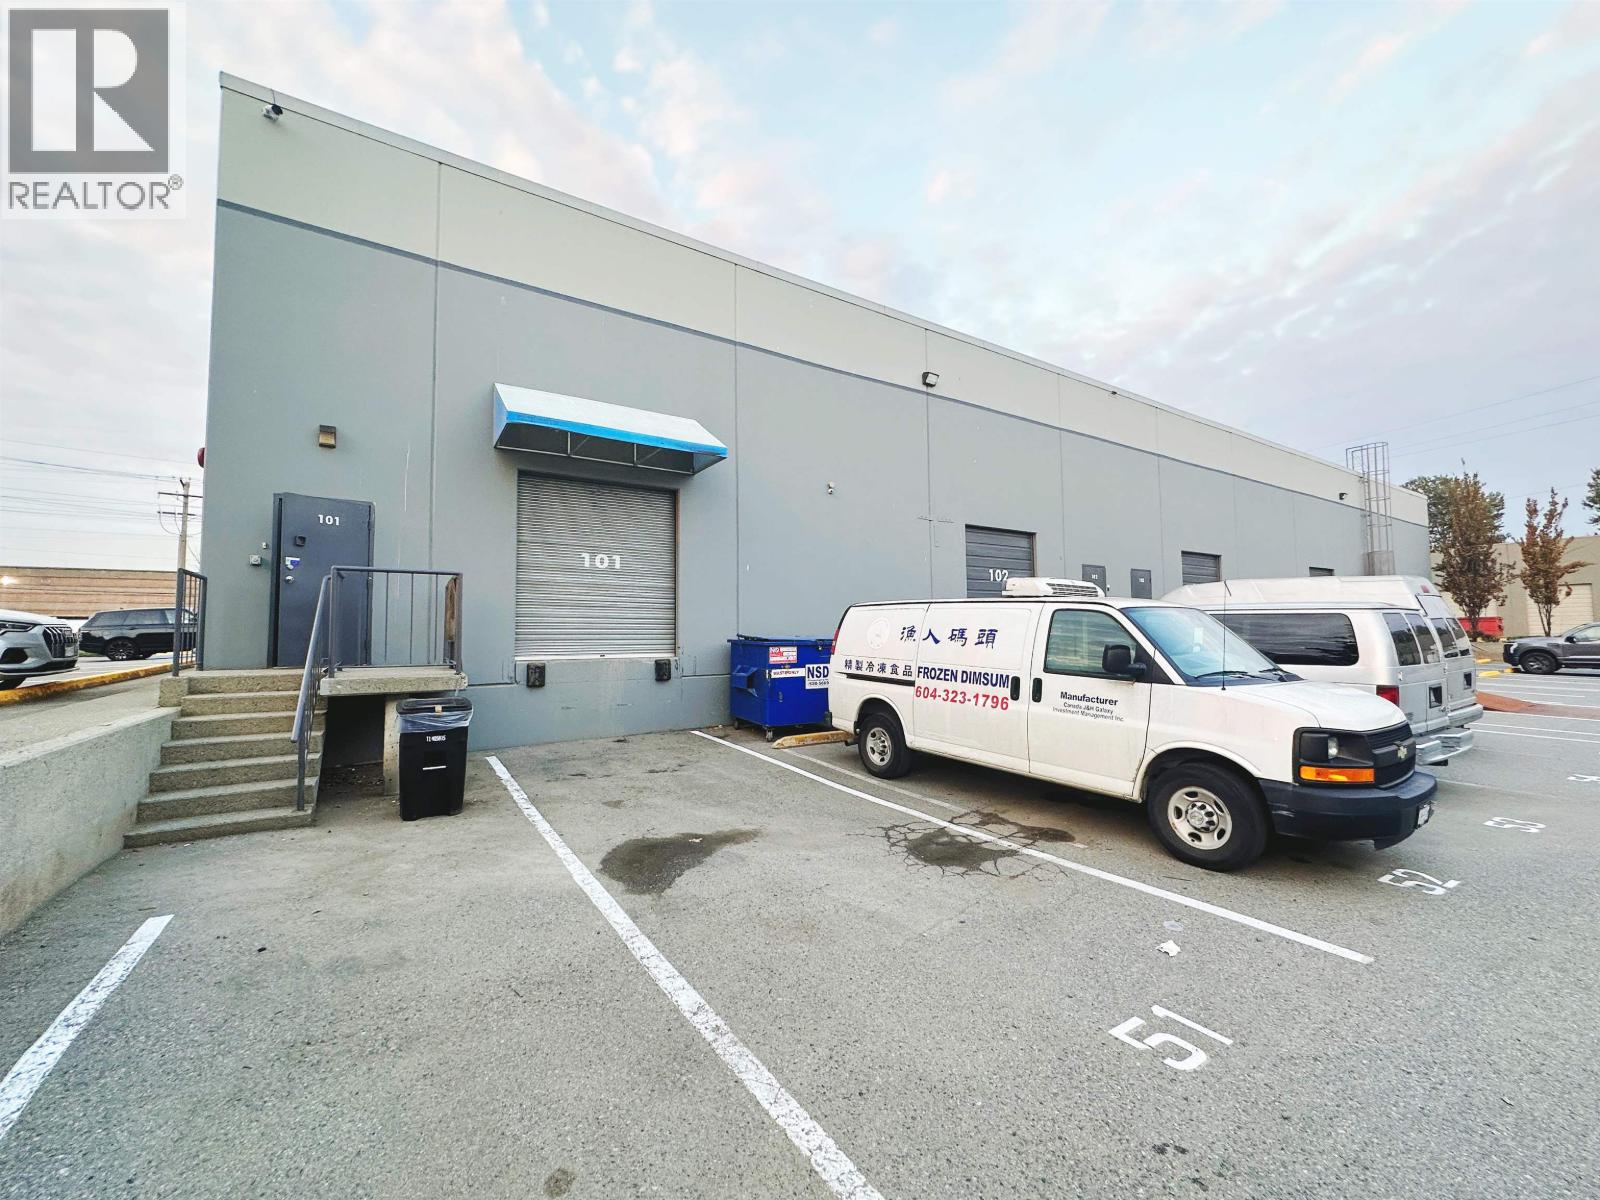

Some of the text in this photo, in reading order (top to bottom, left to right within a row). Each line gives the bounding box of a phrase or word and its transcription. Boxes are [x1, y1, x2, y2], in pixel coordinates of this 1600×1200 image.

[318, 514, 340, 526] 101
[579, 552, 621, 570] 101
[807, 665, 829, 679] NSD
[917, 665, 1010, 689] FROZEN DIMSUM
[915, 686, 1010, 712] 604-323-1796
[1060, 691, 1119, 706] Manufacturer
[1482, 816, 1547, 833] 53
[1377, 868, 1462, 896] 52
[1107, 1004, 1235, 1071] 51
